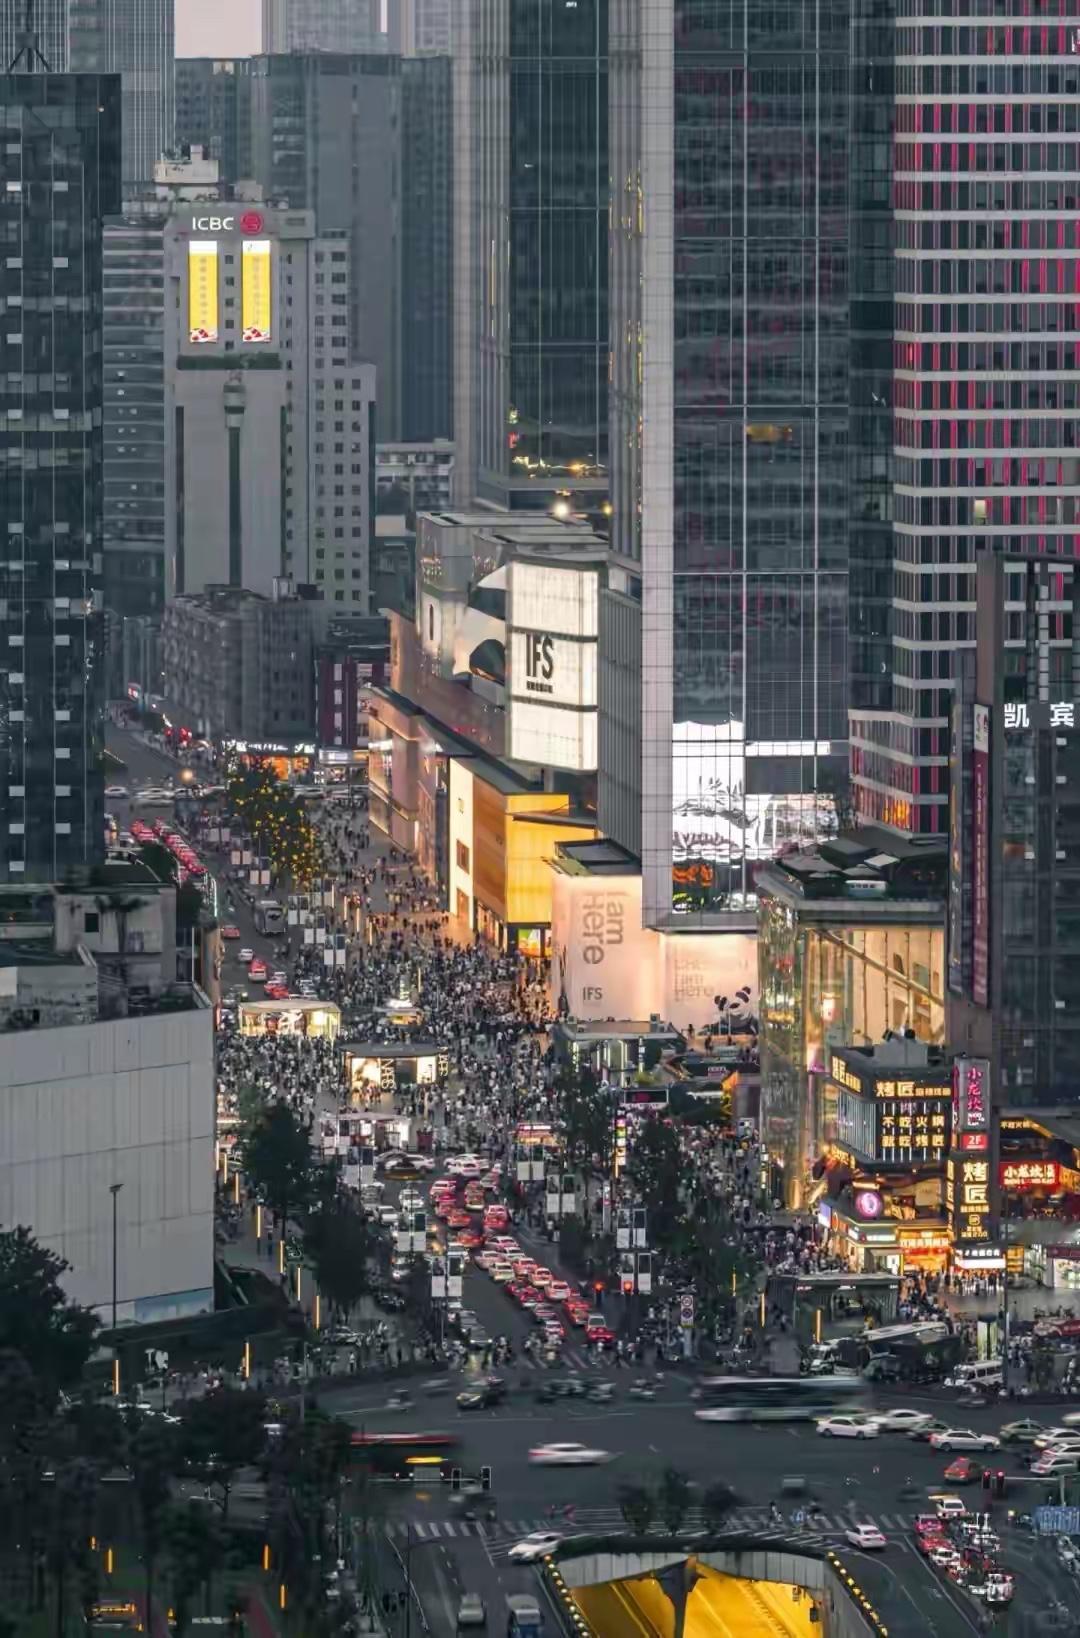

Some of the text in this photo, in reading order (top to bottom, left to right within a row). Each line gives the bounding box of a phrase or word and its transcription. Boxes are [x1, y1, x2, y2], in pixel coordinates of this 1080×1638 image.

[192, 217, 234, 230] ICBC
[526, 633, 554, 679] IFS
[582, 891, 605, 965] Here
[606, 902, 624, 945] am
[583, 986, 602, 1000] IFS
[968, 1135, 983, 1145] 2F
